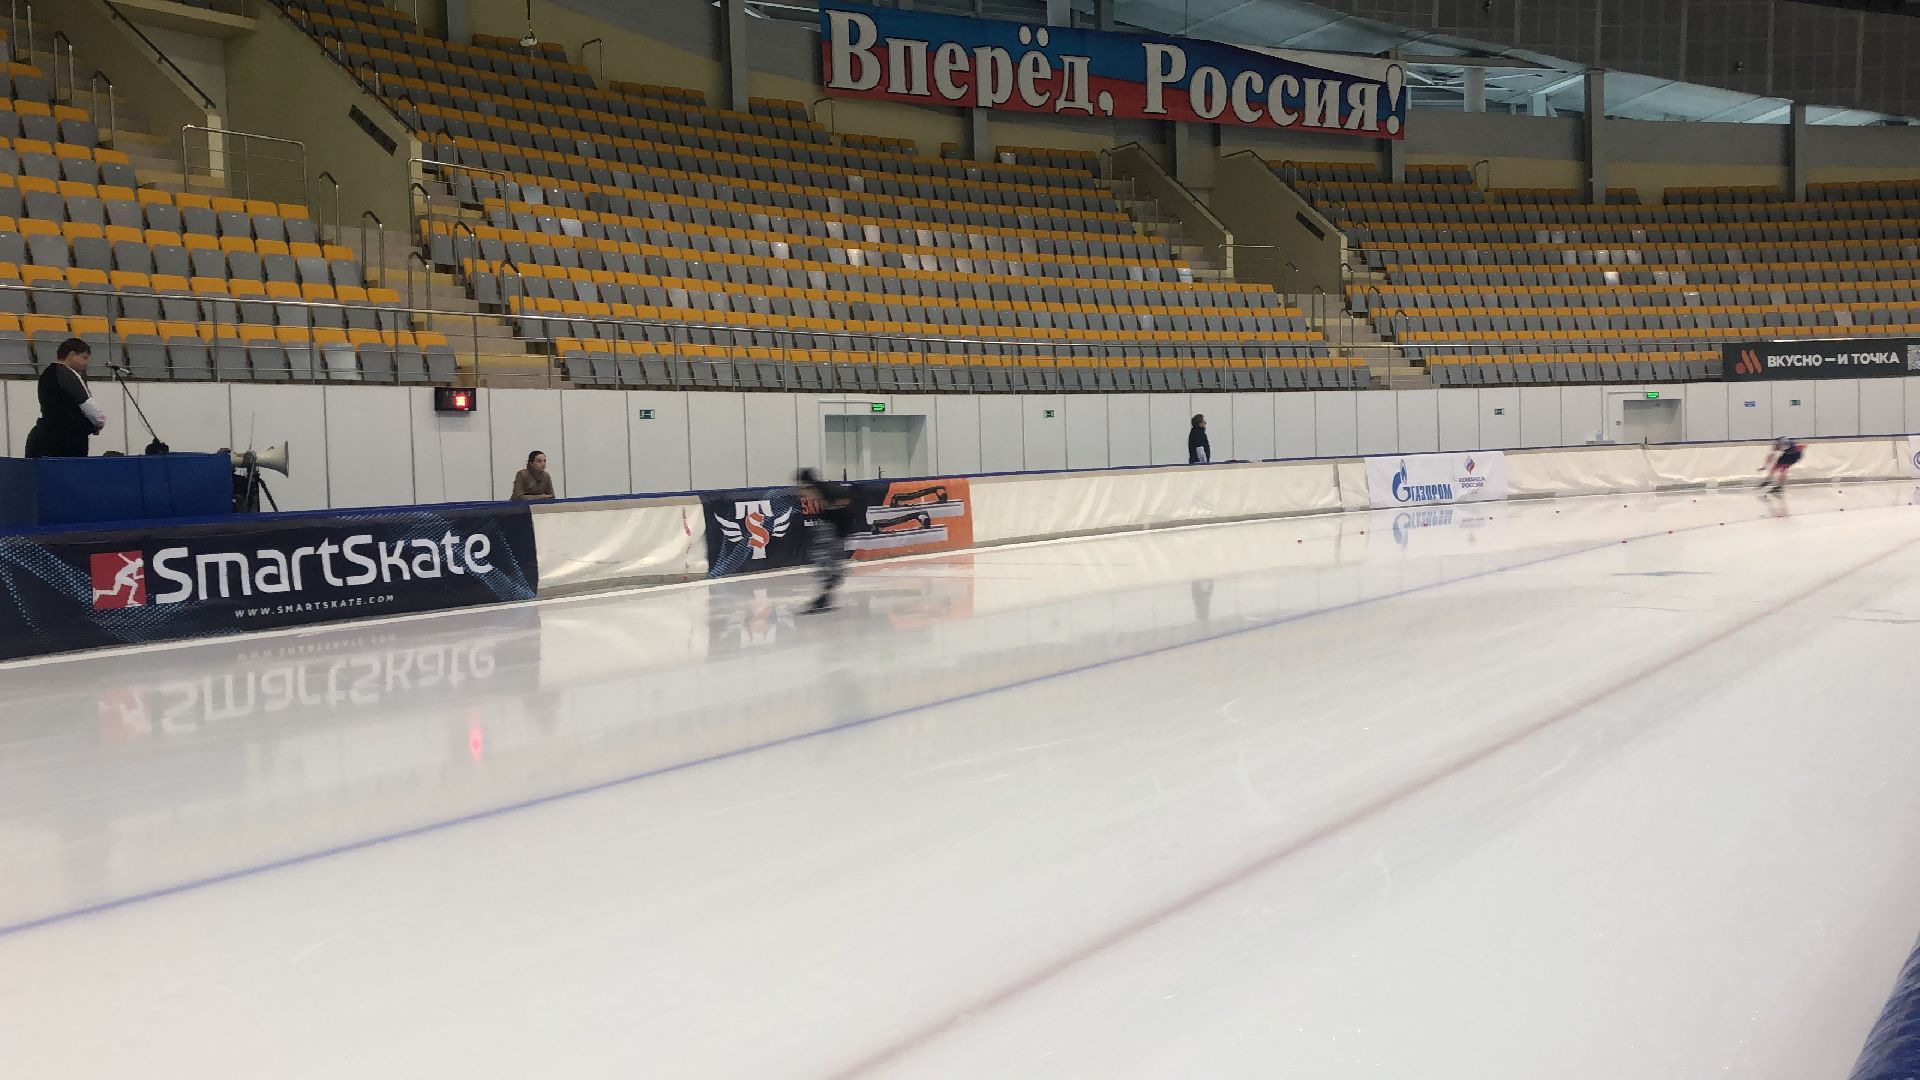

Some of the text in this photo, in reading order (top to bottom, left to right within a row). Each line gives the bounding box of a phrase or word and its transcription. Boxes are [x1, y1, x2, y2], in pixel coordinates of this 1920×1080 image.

[824, 9, 1405, 136] Вперёд, Россия!
[1767, 354, 1822, 368] ВКУСНО
[1850, 351, 1900, 365] ТОЧКА
[152, 533, 494, 604] SmartSkate
[234, 593, 395, 619] WWW.SMARTSKATE.COM
